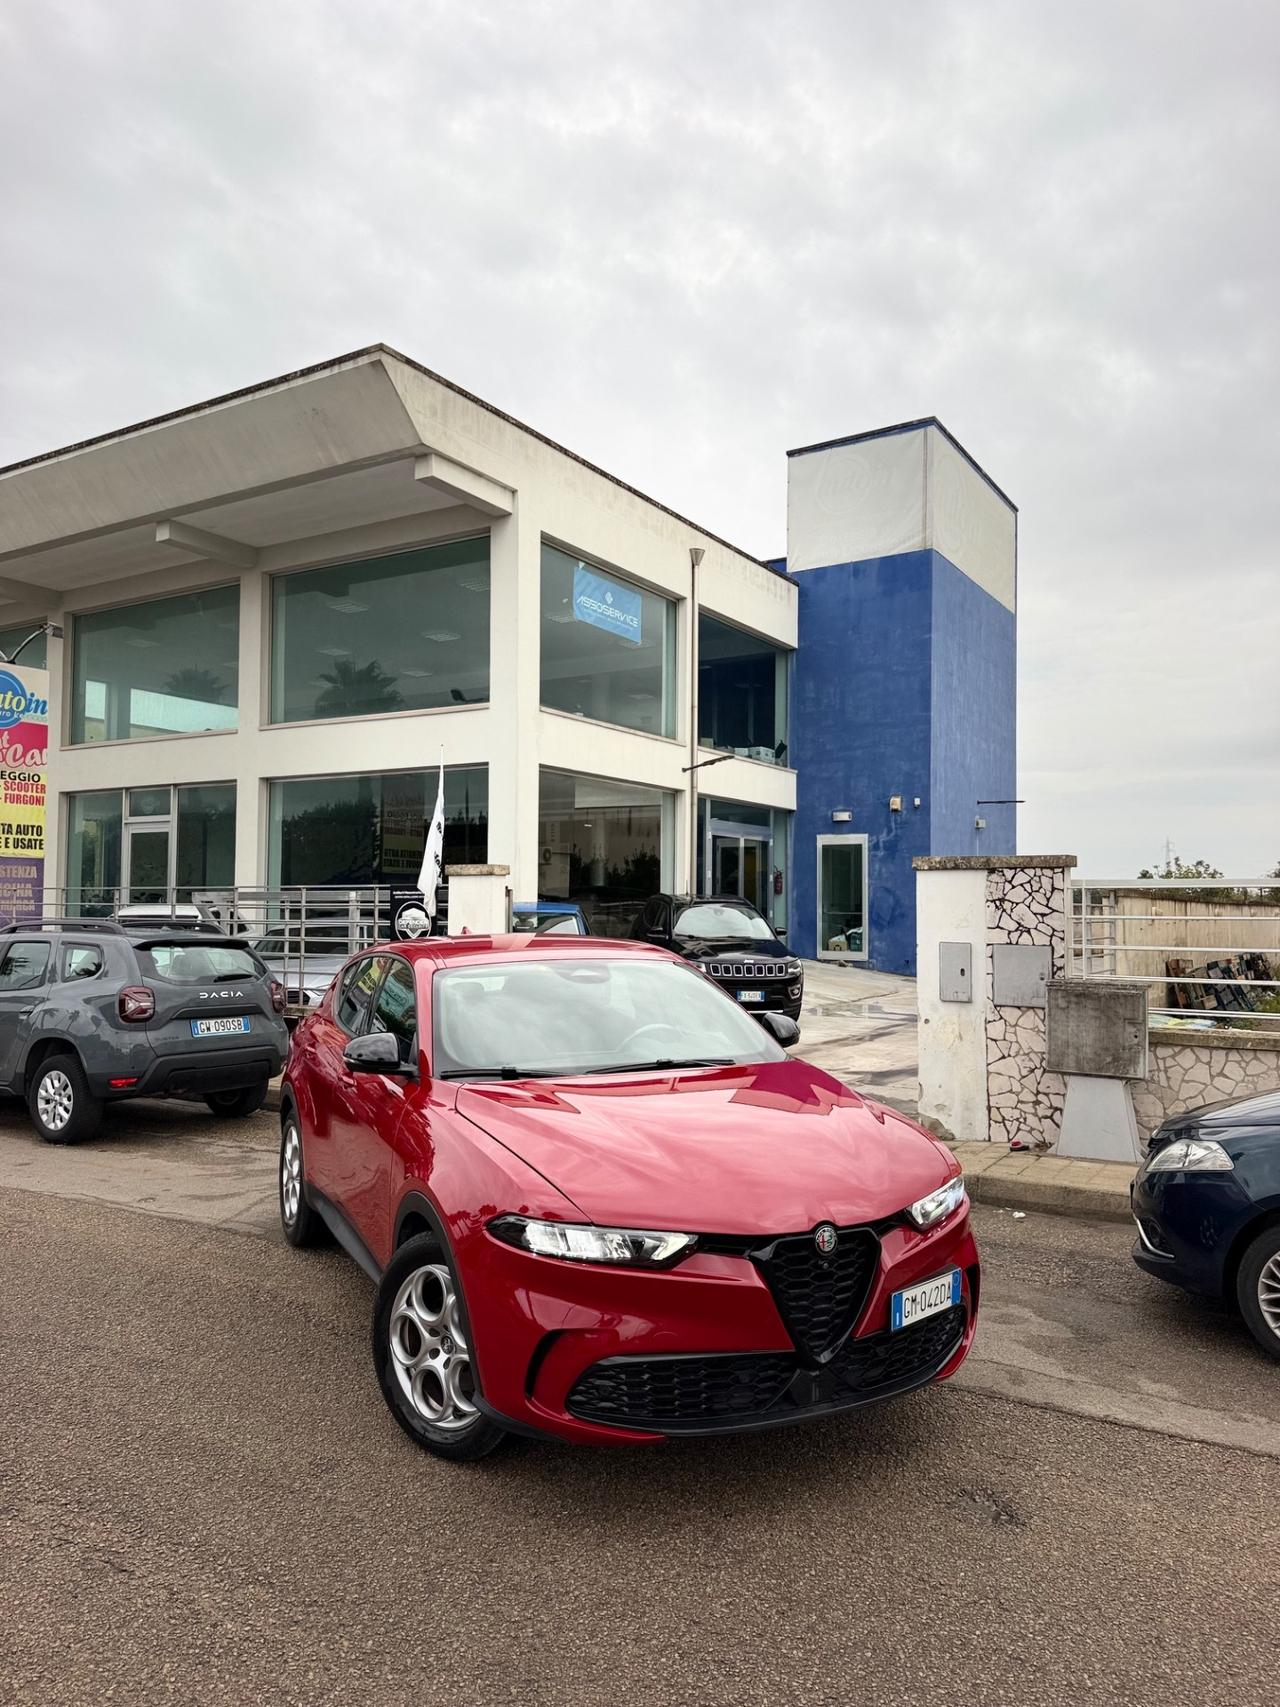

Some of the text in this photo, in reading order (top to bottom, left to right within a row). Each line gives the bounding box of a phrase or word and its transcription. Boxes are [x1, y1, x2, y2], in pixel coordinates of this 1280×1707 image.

[0, 770, 41, 783] EGGIO
[3, 780, 46, 794] SCOOTER
[4, 792, 45, 806] FURGONI
[15, 823, 43, 837] AUTO
[13, 837, 44, 850] USATE
[199, 991, 244, 999] DACIA
